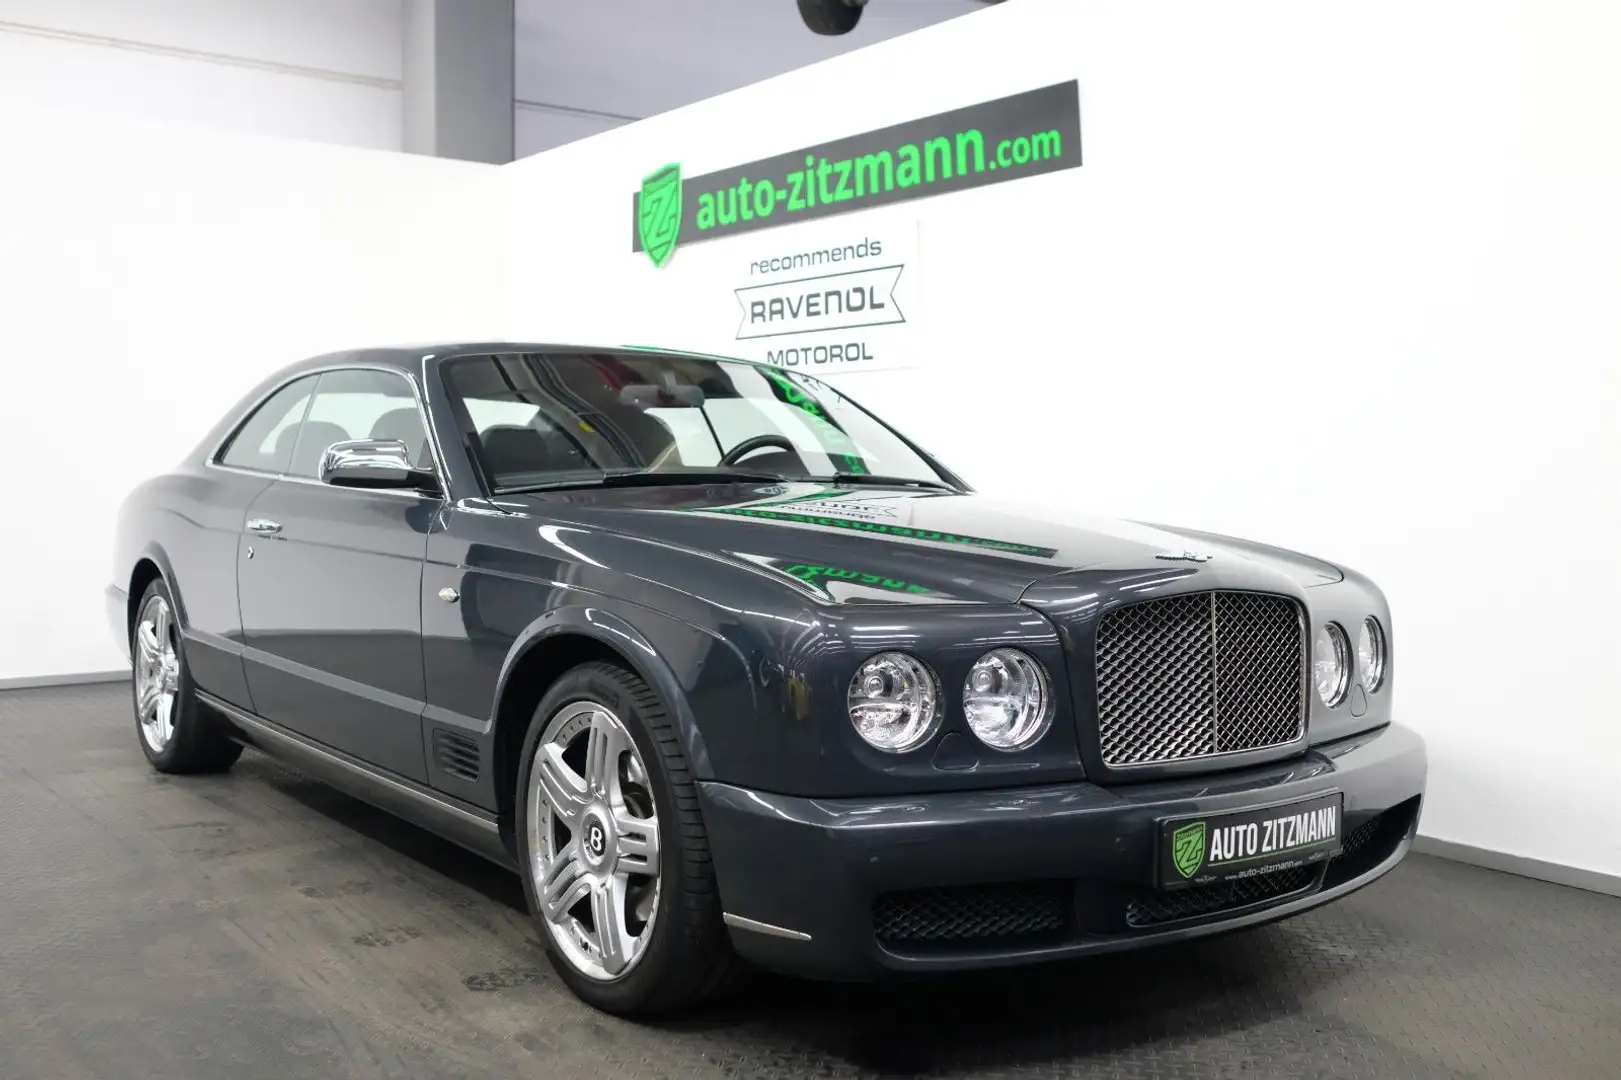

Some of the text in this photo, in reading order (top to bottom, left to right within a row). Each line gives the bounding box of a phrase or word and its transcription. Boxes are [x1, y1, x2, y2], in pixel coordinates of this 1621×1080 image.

[696, 128, 1062, 230] auto-zitzmann.com
[750, 237, 882, 275] recommends
[751, 286, 885, 324] RAVENOL
[767, 342, 874, 367] MOTOROL
[1209, 805, 1337, 862] AUTO ZITZMANN
